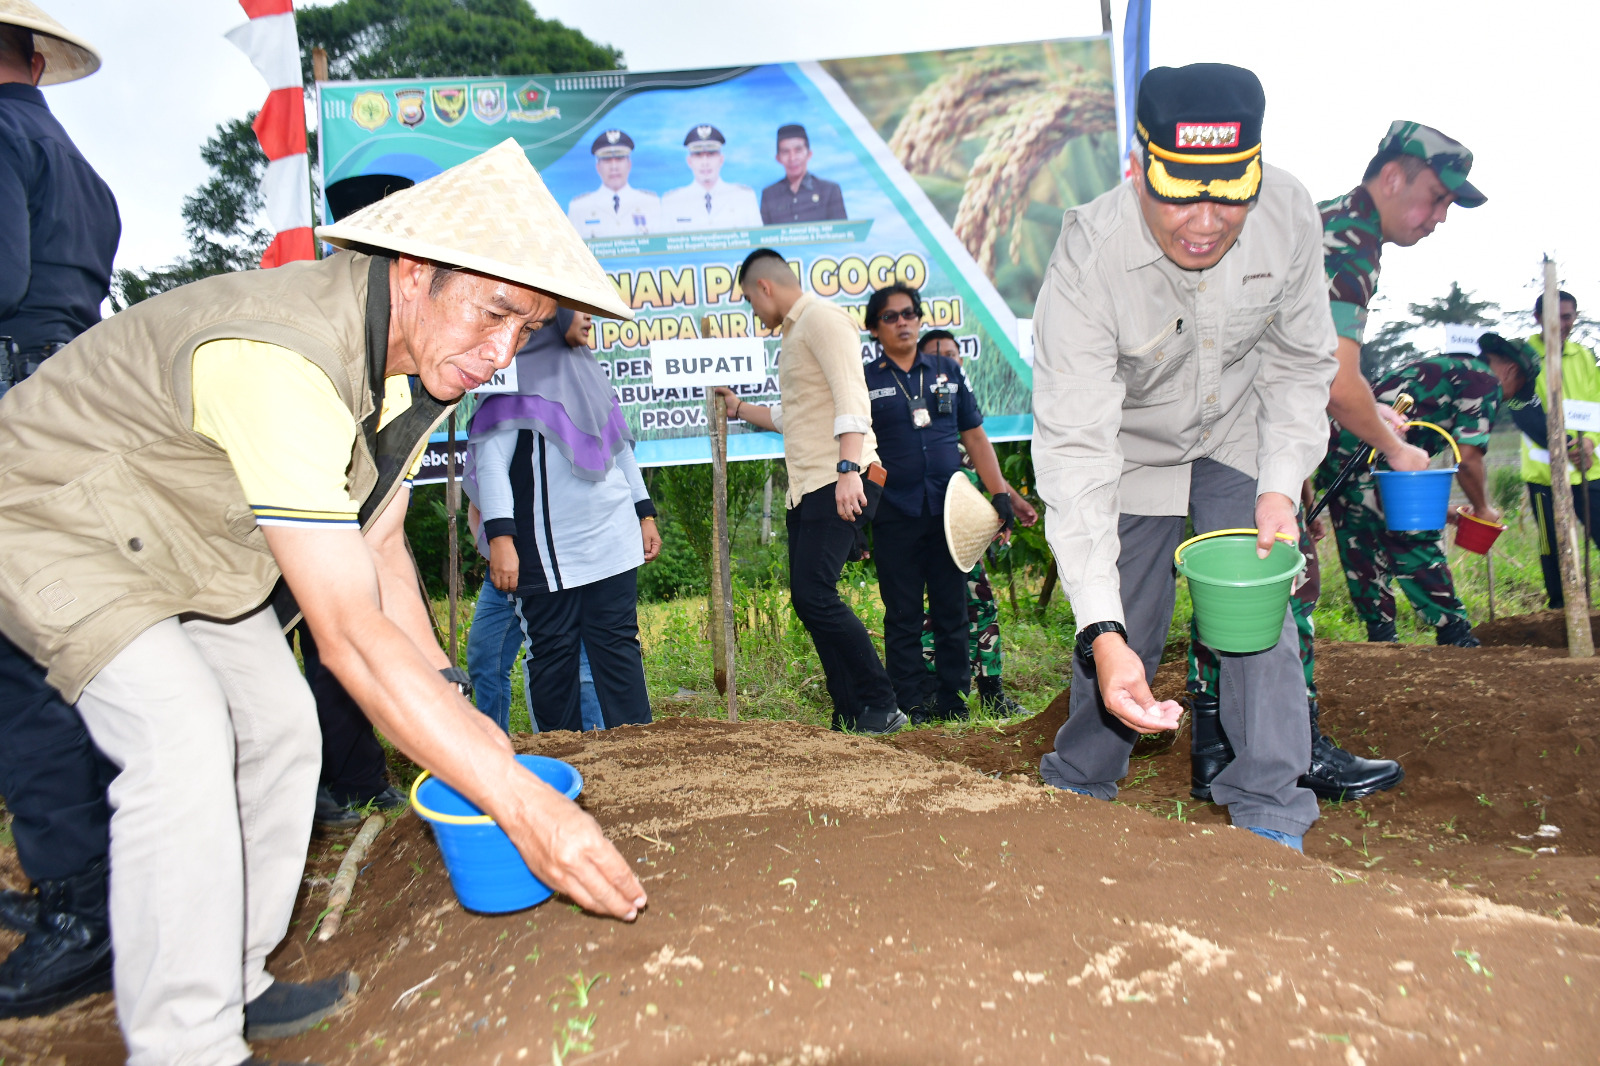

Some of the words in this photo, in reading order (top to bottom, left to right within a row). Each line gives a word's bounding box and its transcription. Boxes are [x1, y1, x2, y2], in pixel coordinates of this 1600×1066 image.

[607, 267, 696, 309] NAM
[810, 253, 926, 296] GOGO
[602, 315, 699, 349] POMPA
[707, 312, 749, 338] AIR
[919, 299, 961, 327] ADI
[665, 356, 752, 375] BUPATI
[642, 408, 706, 428] PROV.
